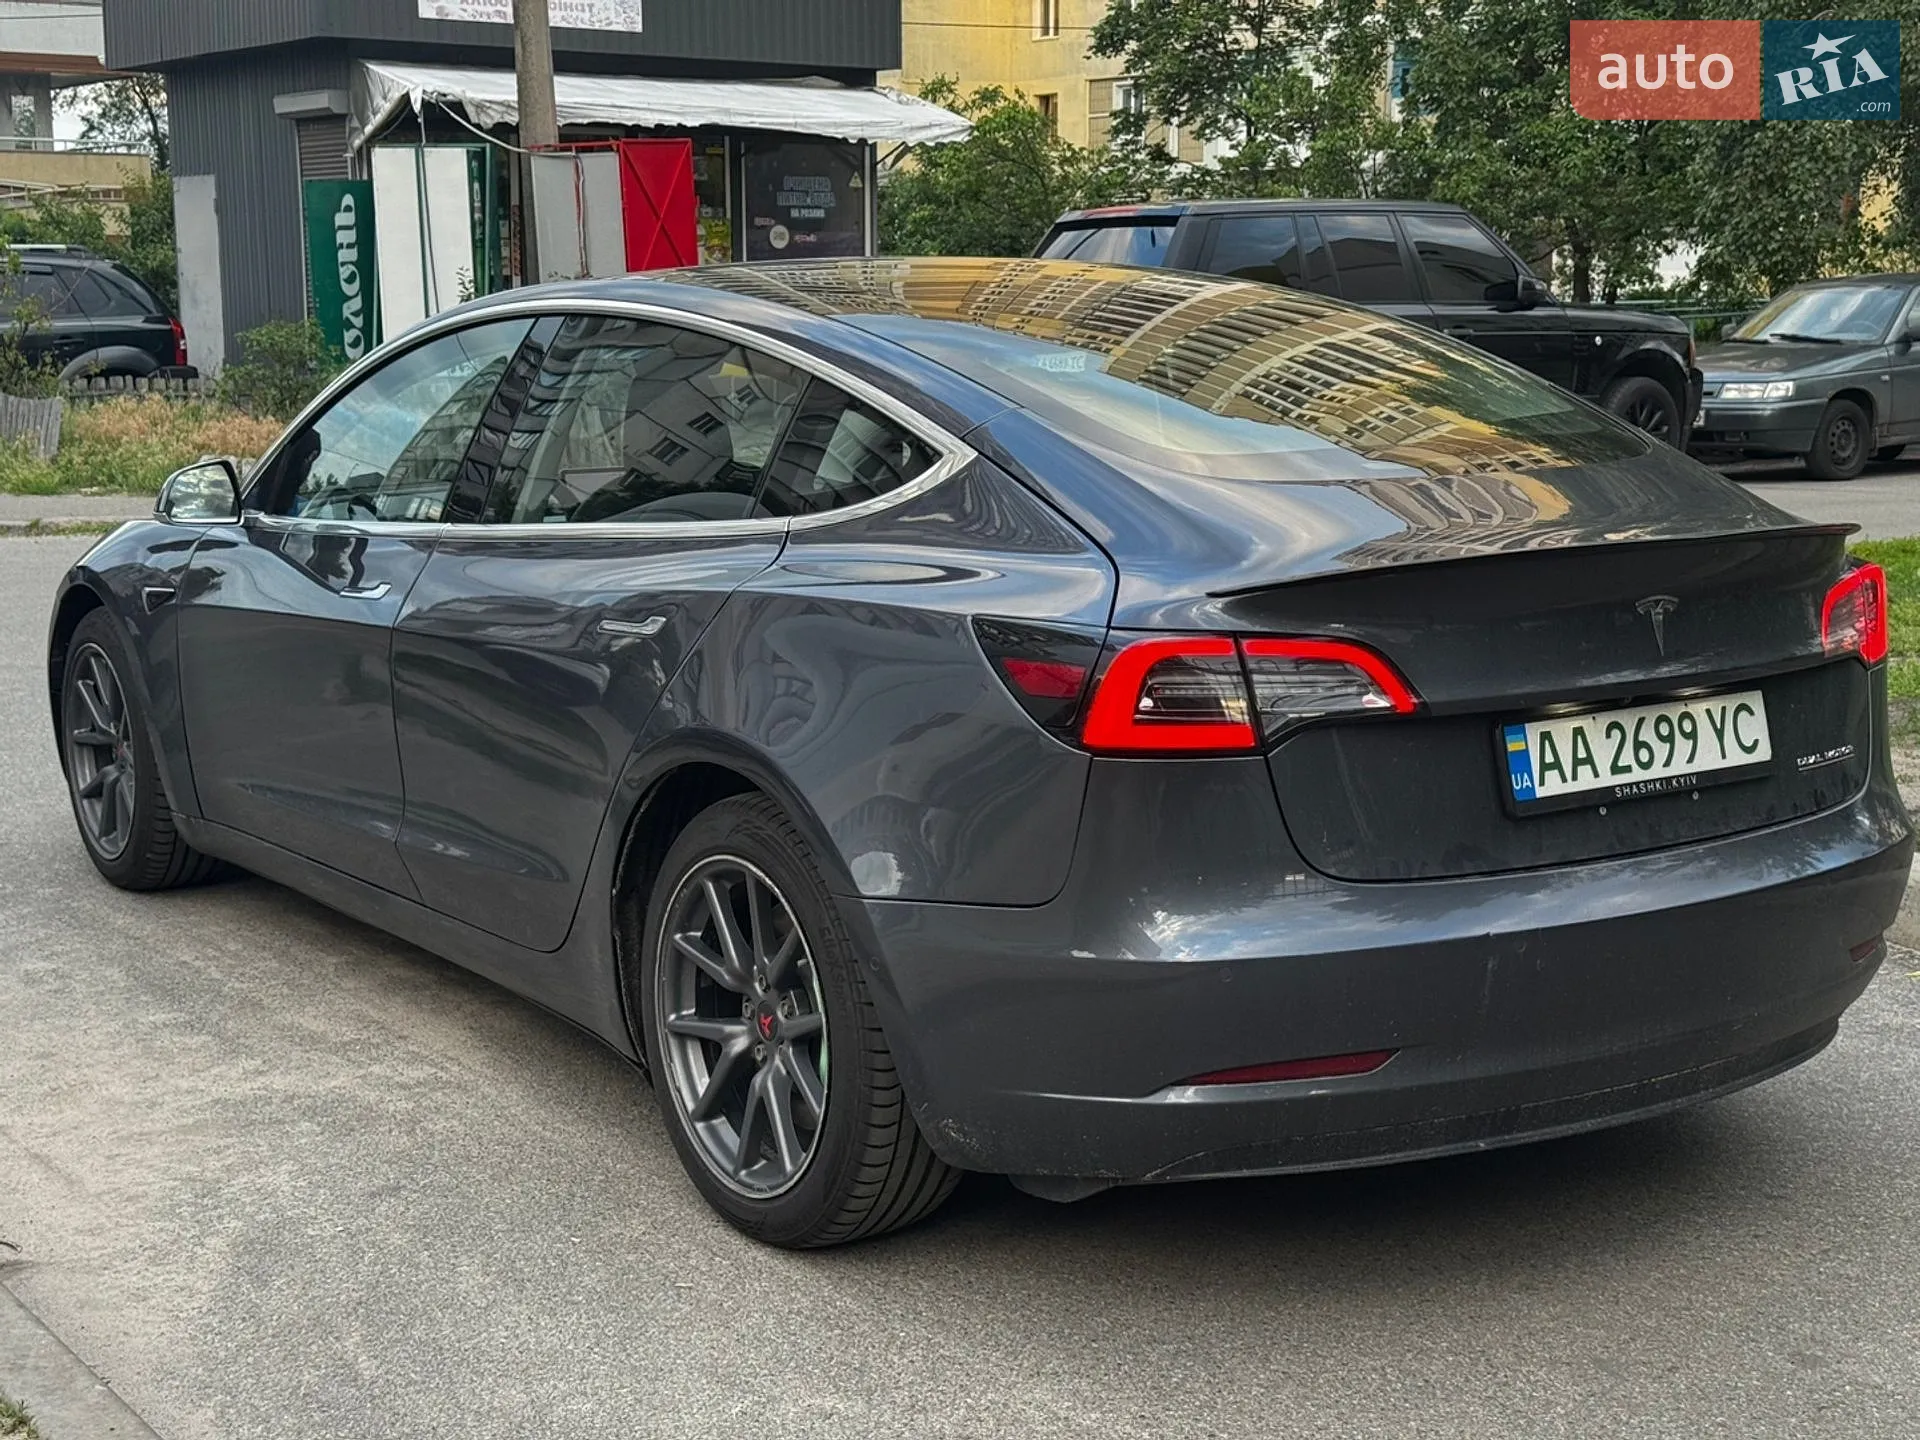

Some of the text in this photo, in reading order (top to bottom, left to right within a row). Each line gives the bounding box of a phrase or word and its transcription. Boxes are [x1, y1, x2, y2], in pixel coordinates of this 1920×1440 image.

[1538, 702, 1760, 787] AA 2699 YC
[1511, 771, 1533, 791] UA
[1615, 774, 1698, 799] SHASHKI.KYIV
